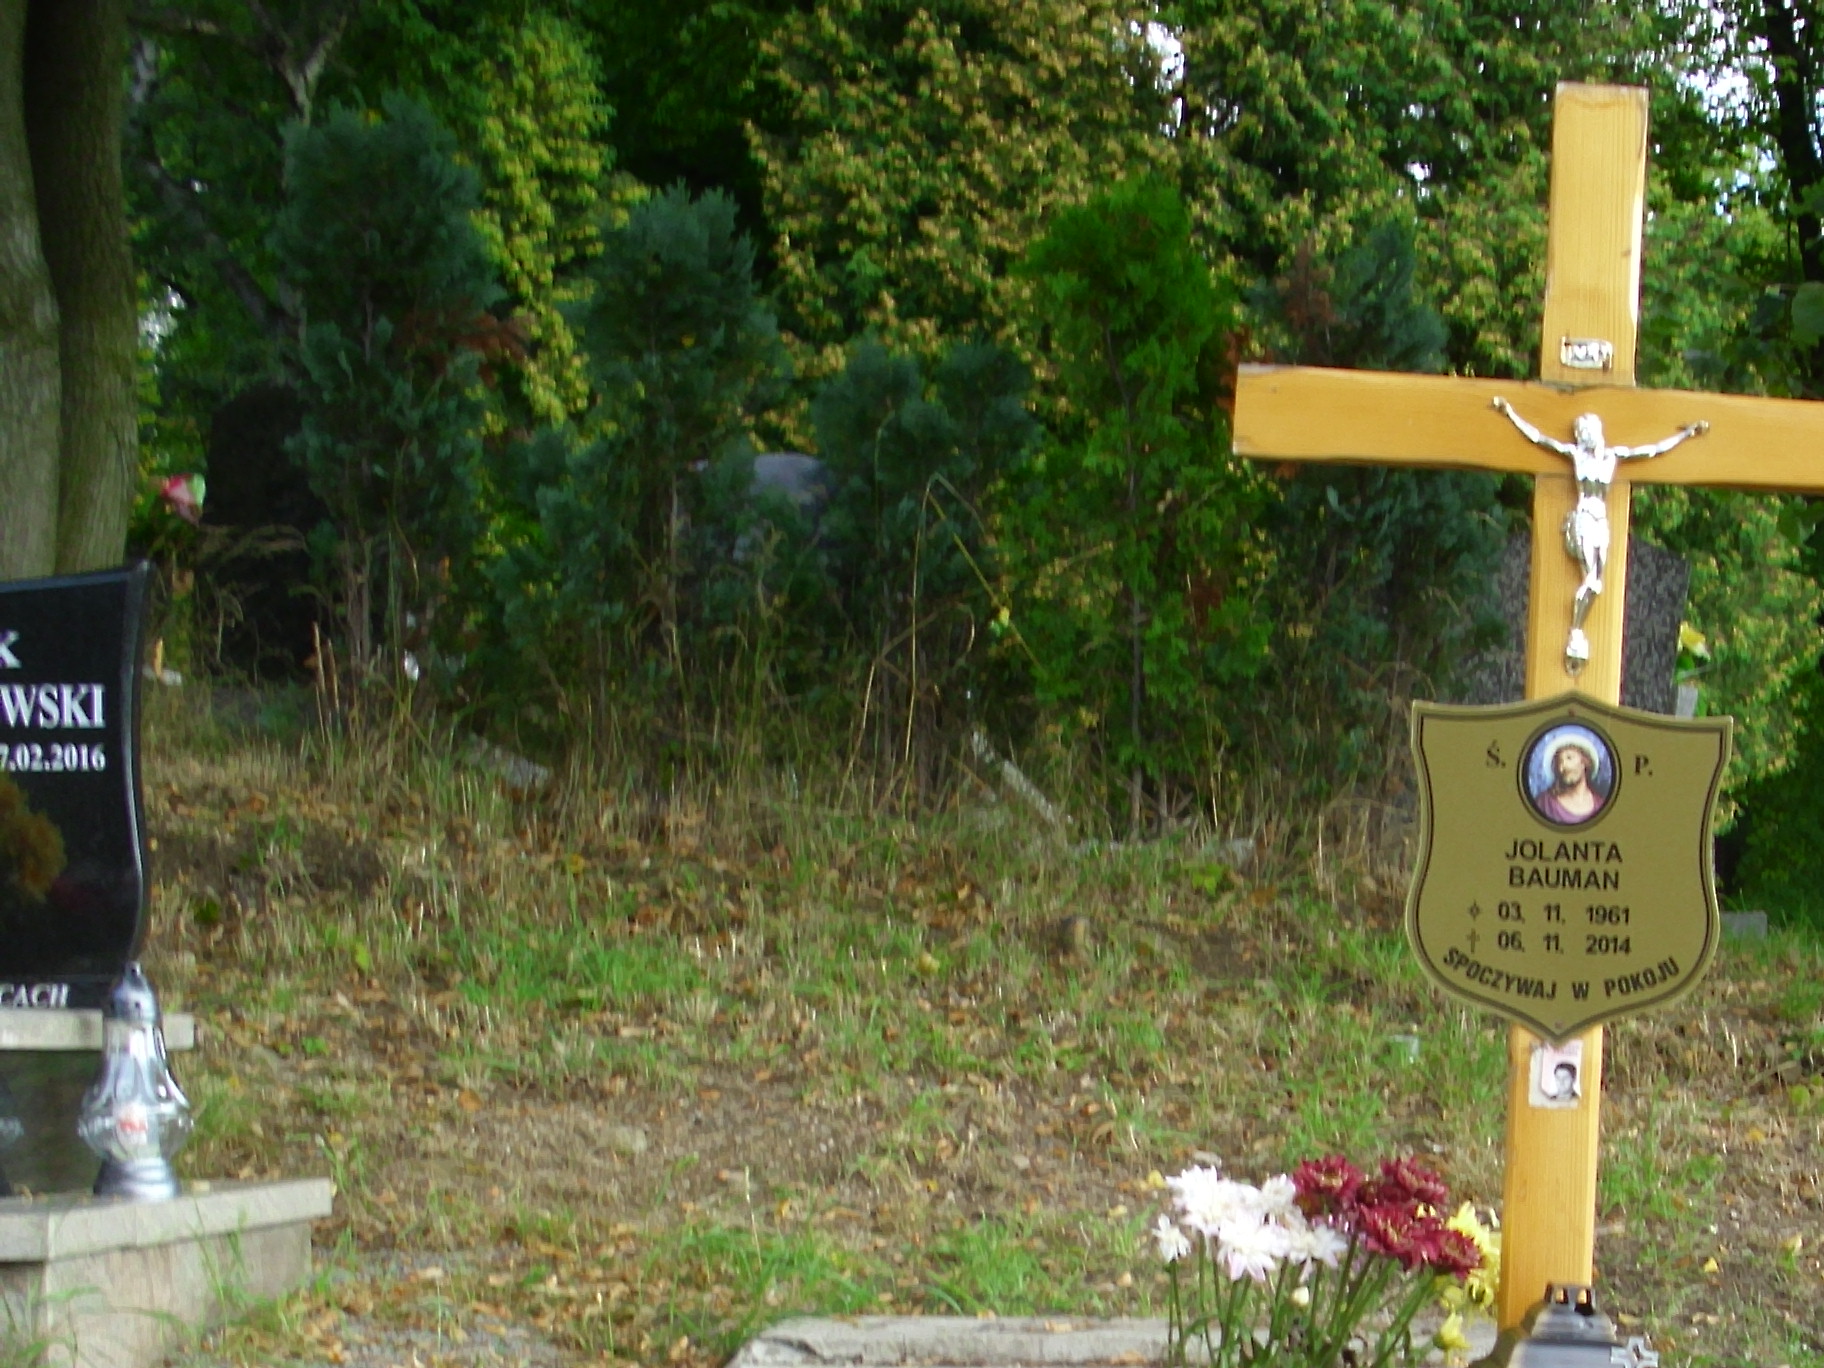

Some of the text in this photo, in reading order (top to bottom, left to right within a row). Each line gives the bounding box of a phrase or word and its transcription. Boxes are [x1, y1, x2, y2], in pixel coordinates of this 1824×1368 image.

[1634, 753, 1653, 776] P.
[1505, 838, 1623, 864] JOLANTA
[1508, 866, 1620, 890] BAUMAN
[1586, 905, 1630, 926] 1961
[1586, 935, 1631, 956] 2014
[1443, 947, 1681, 1000] SPOCZYWAJ W POKOJU
